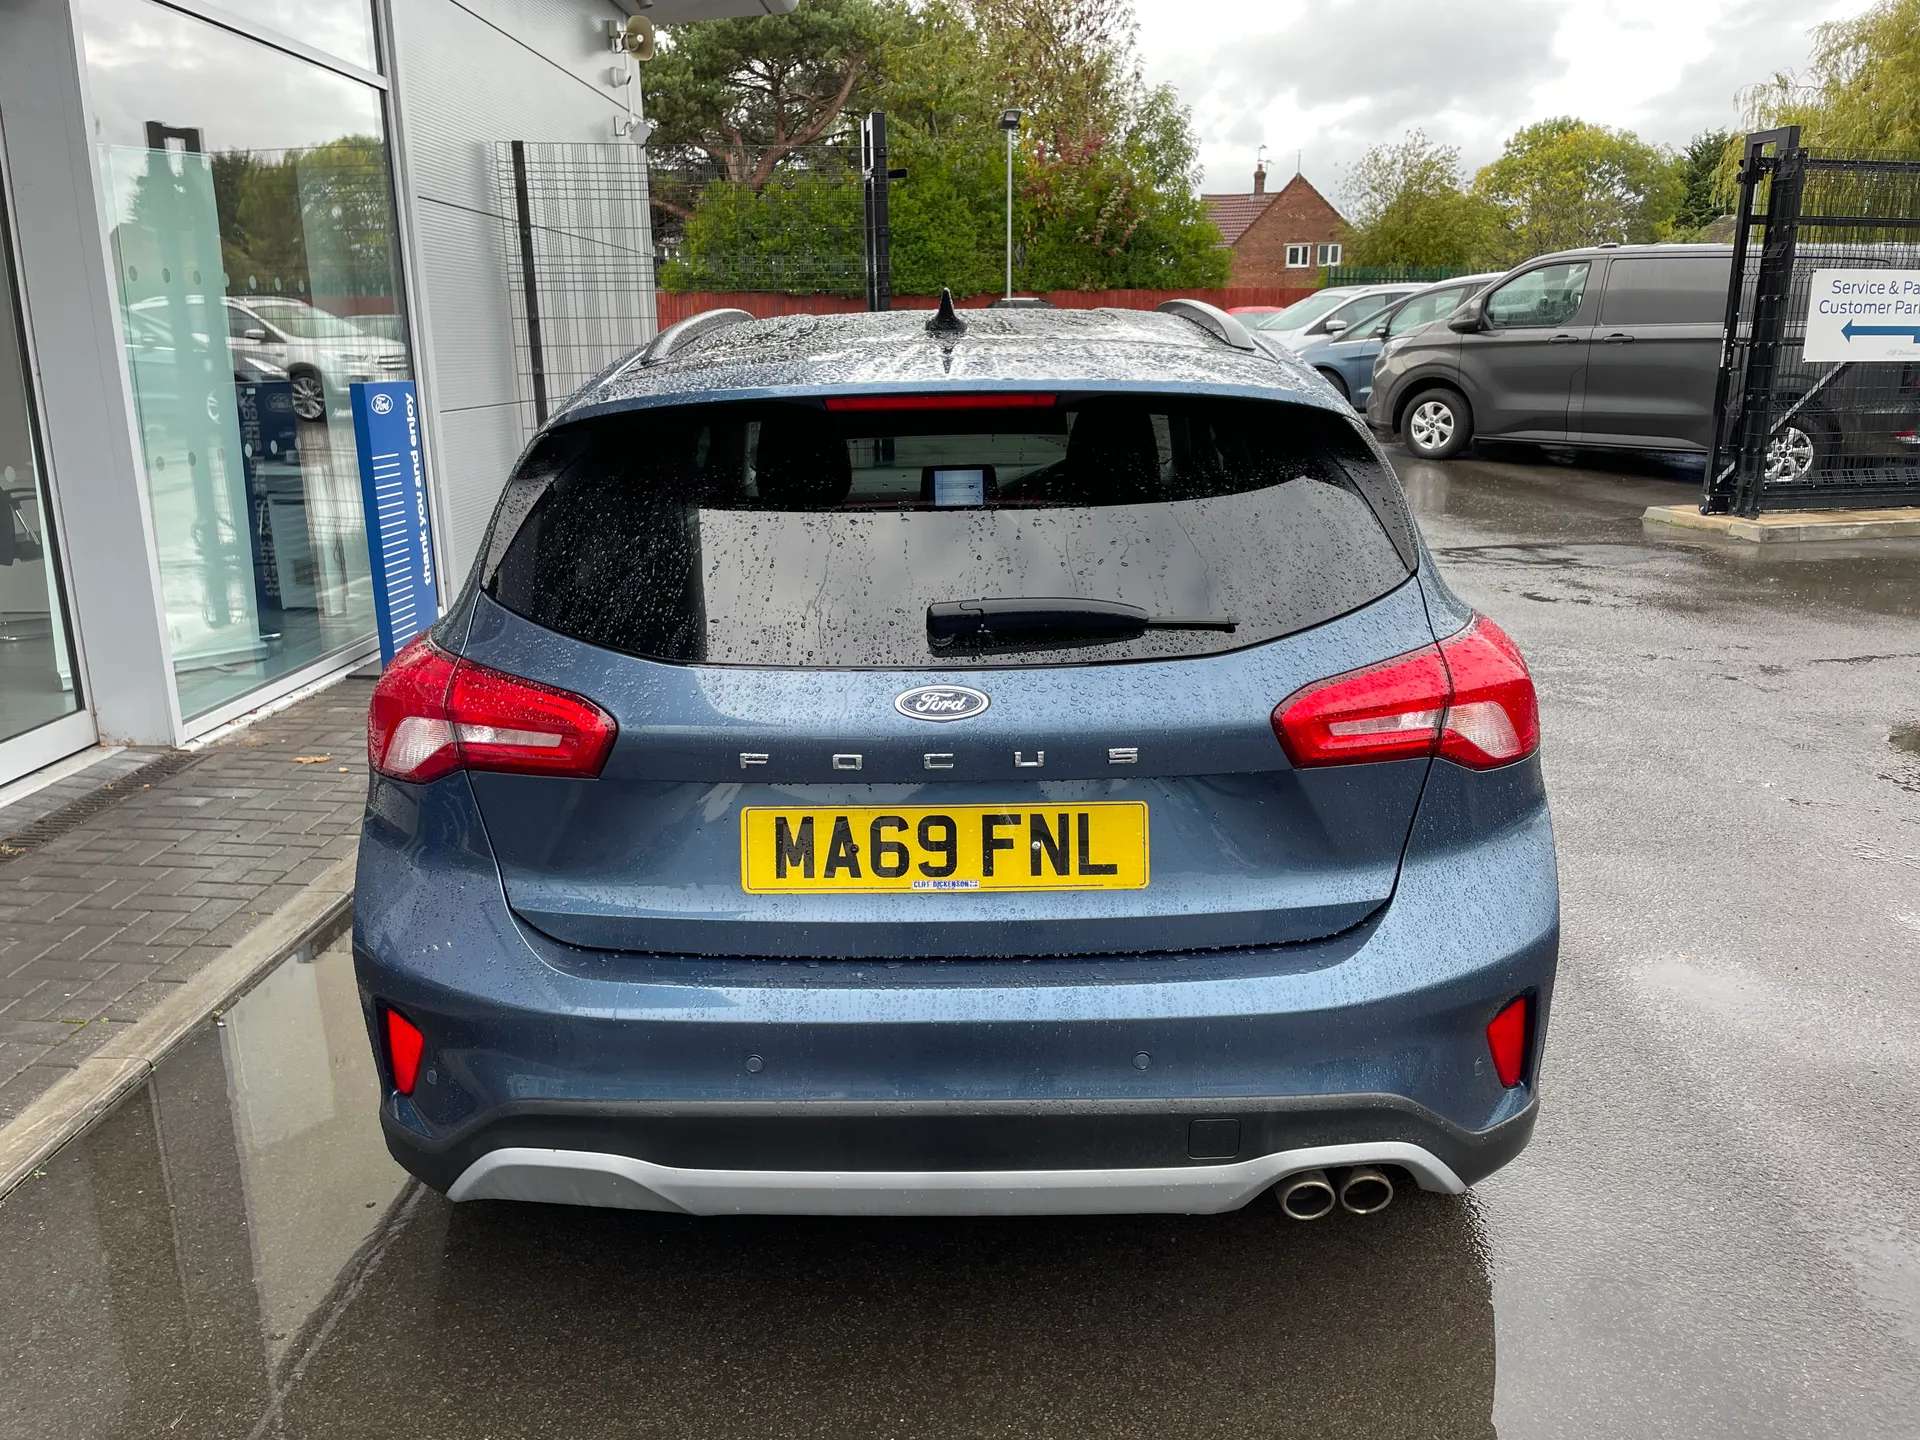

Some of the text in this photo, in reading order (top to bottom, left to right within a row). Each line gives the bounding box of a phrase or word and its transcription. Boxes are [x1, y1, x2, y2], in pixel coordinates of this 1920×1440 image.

[1832, 279, 1885, 294] Service
[1888, 280, 1899, 294] &
[1819, 299, 1920, 314] Customer Par
[373, 395, 391, 412] Ford
[405, 392, 432, 586] thank you and enjoy
[915, 690, 967, 713] Ford
[740, 747, 1138, 769] FOCUS
[774, 813, 1118, 878] MA69 FNL
